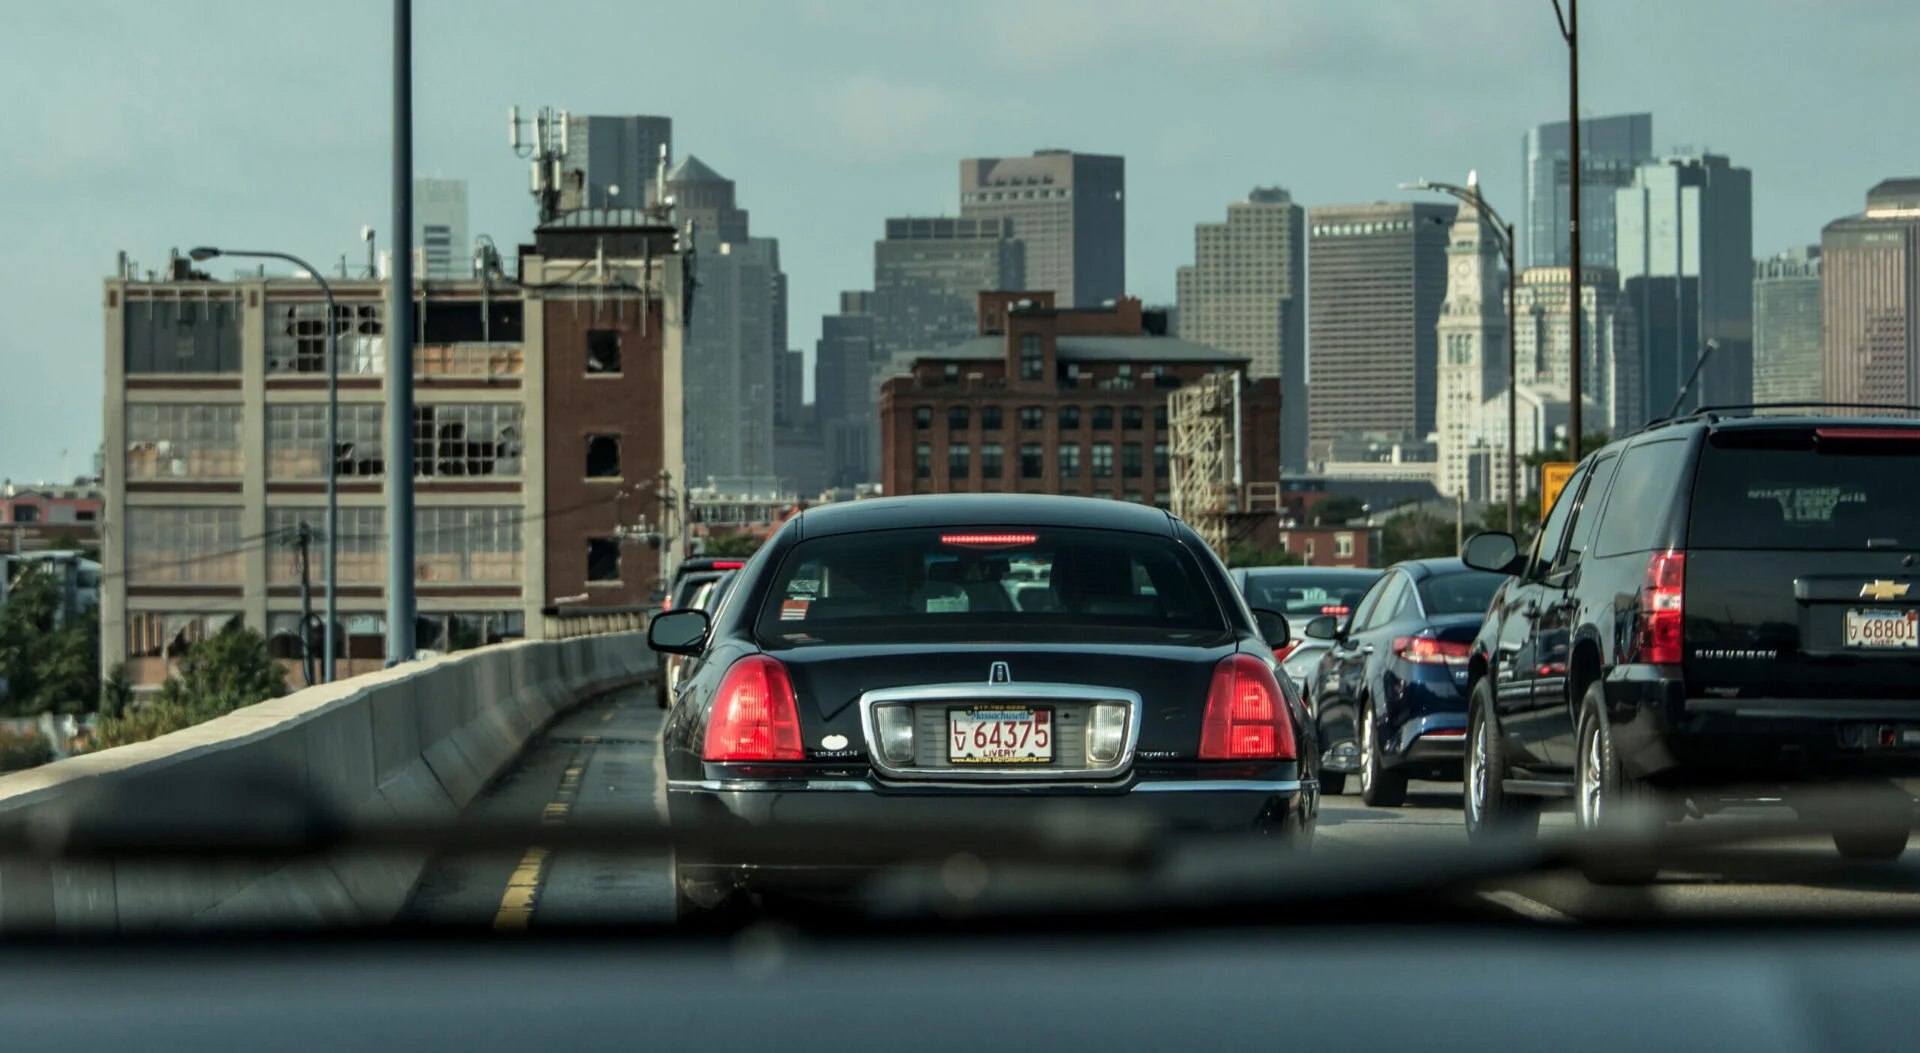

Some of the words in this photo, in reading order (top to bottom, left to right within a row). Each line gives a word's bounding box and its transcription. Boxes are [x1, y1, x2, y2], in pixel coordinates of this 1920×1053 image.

[1863, 619, 1916, 640] 68801
[972, 711, 1029, 720] Massachusetts
[974, 721, 1049, 749] 64375
[983, 749, 1017, 757] LIVERY
